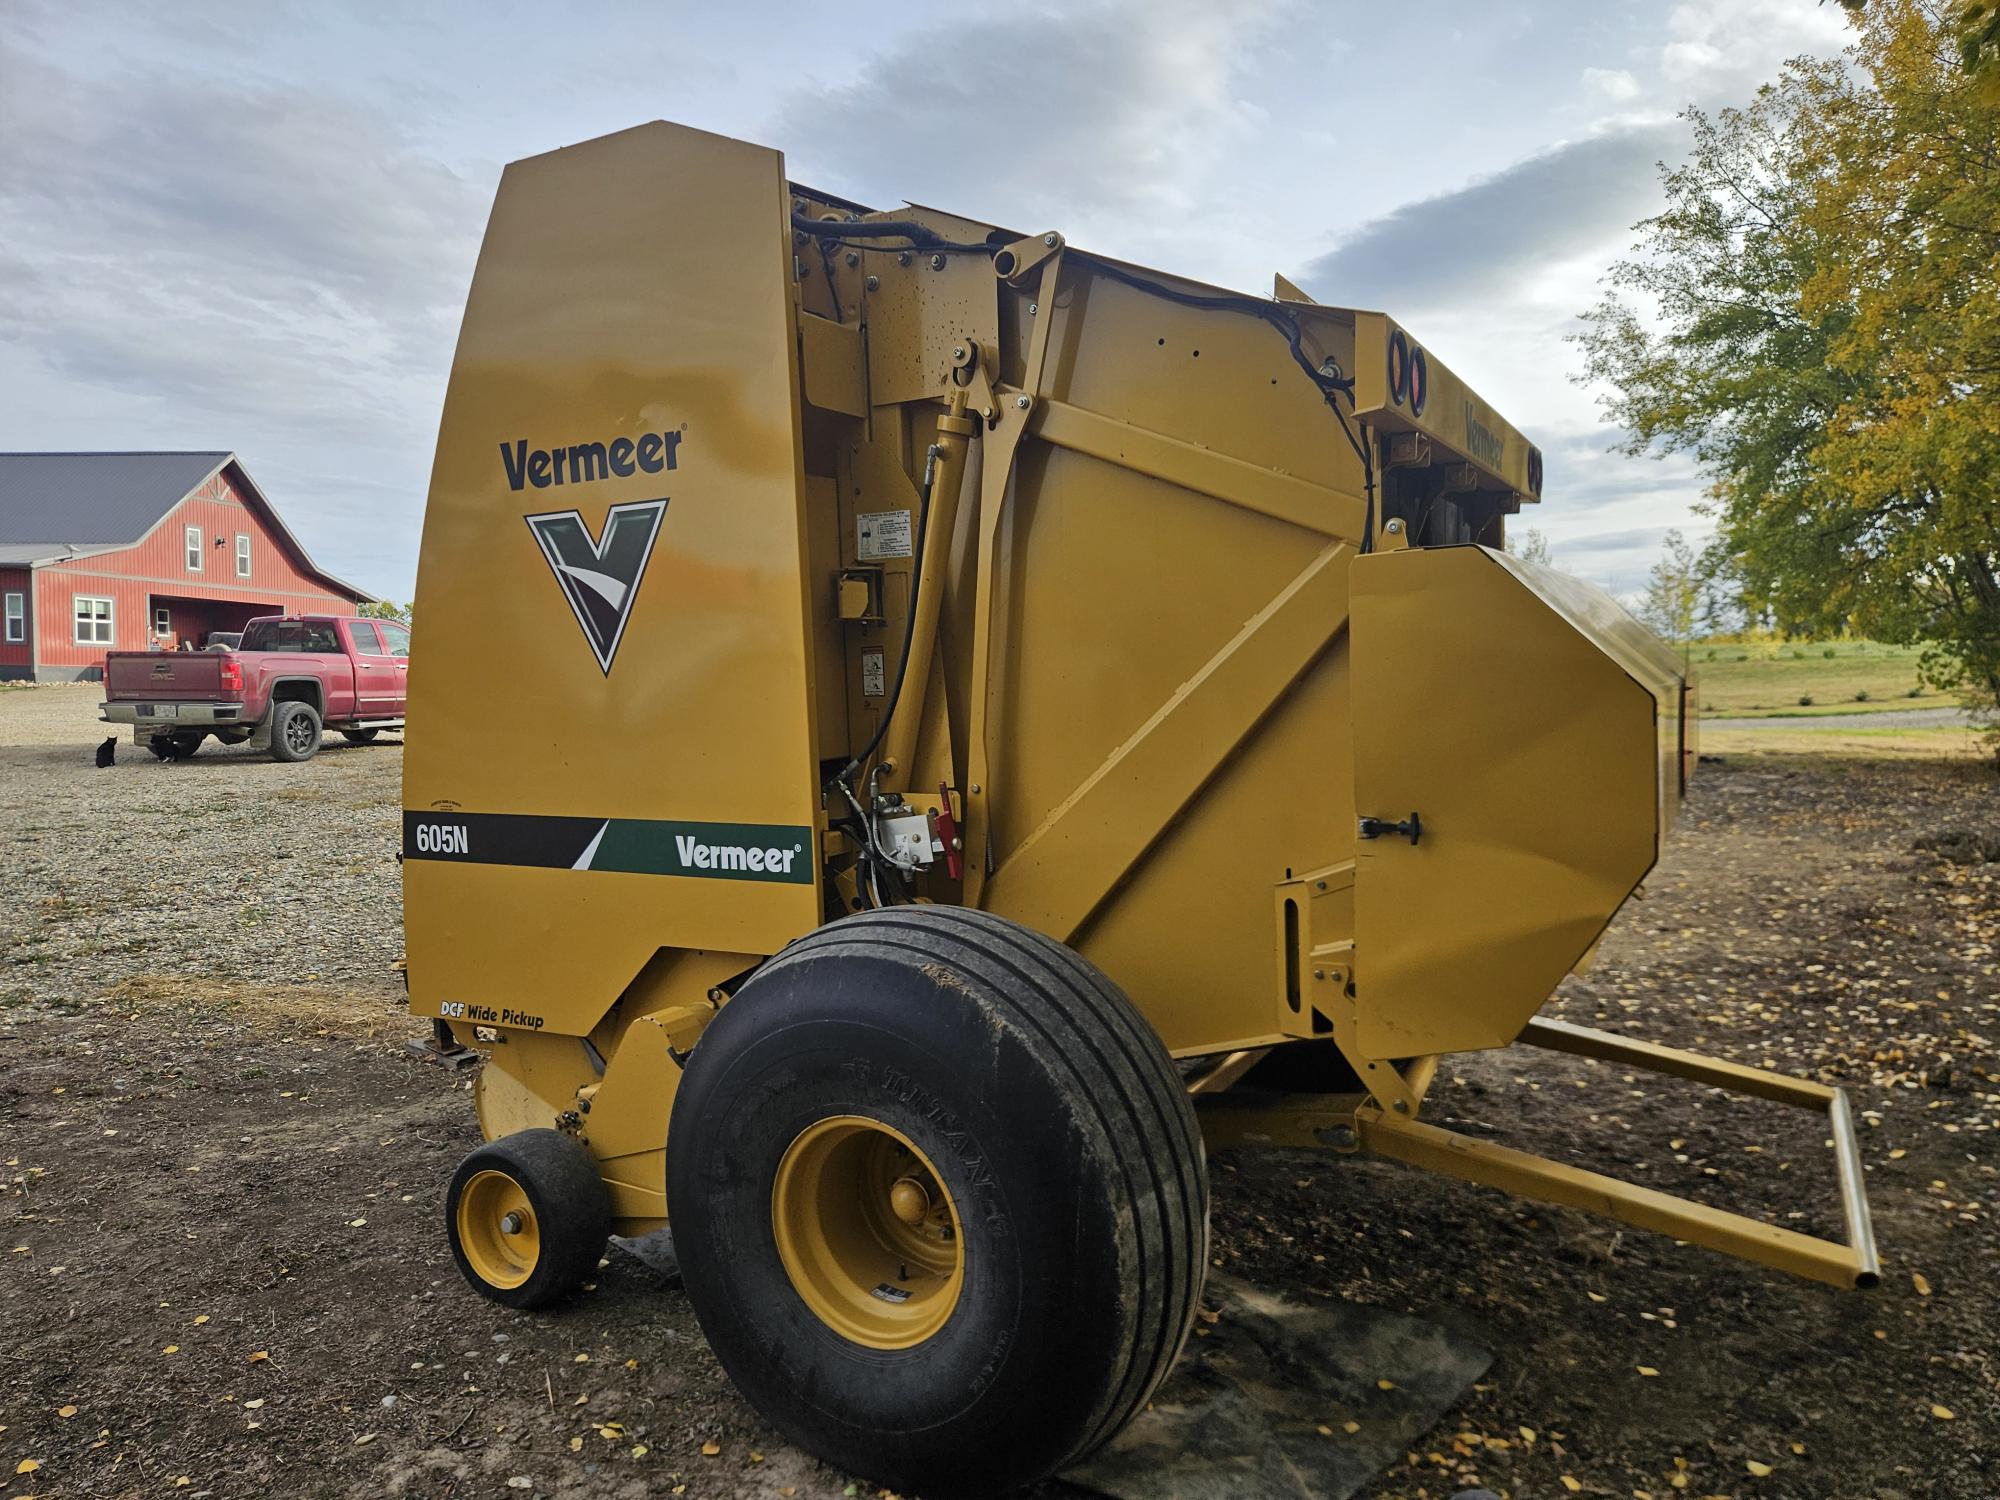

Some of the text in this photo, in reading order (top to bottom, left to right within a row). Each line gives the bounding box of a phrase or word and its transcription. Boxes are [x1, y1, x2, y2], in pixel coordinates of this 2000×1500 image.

[499, 430, 682, 491] Vermeer
[416, 824, 469, 854] 605N
[675, 835, 795, 873] Vermeer
[440, 1000, 544, 1031] DCF Wide Pickup
[881, 1064, 997, 1189] TITAN
